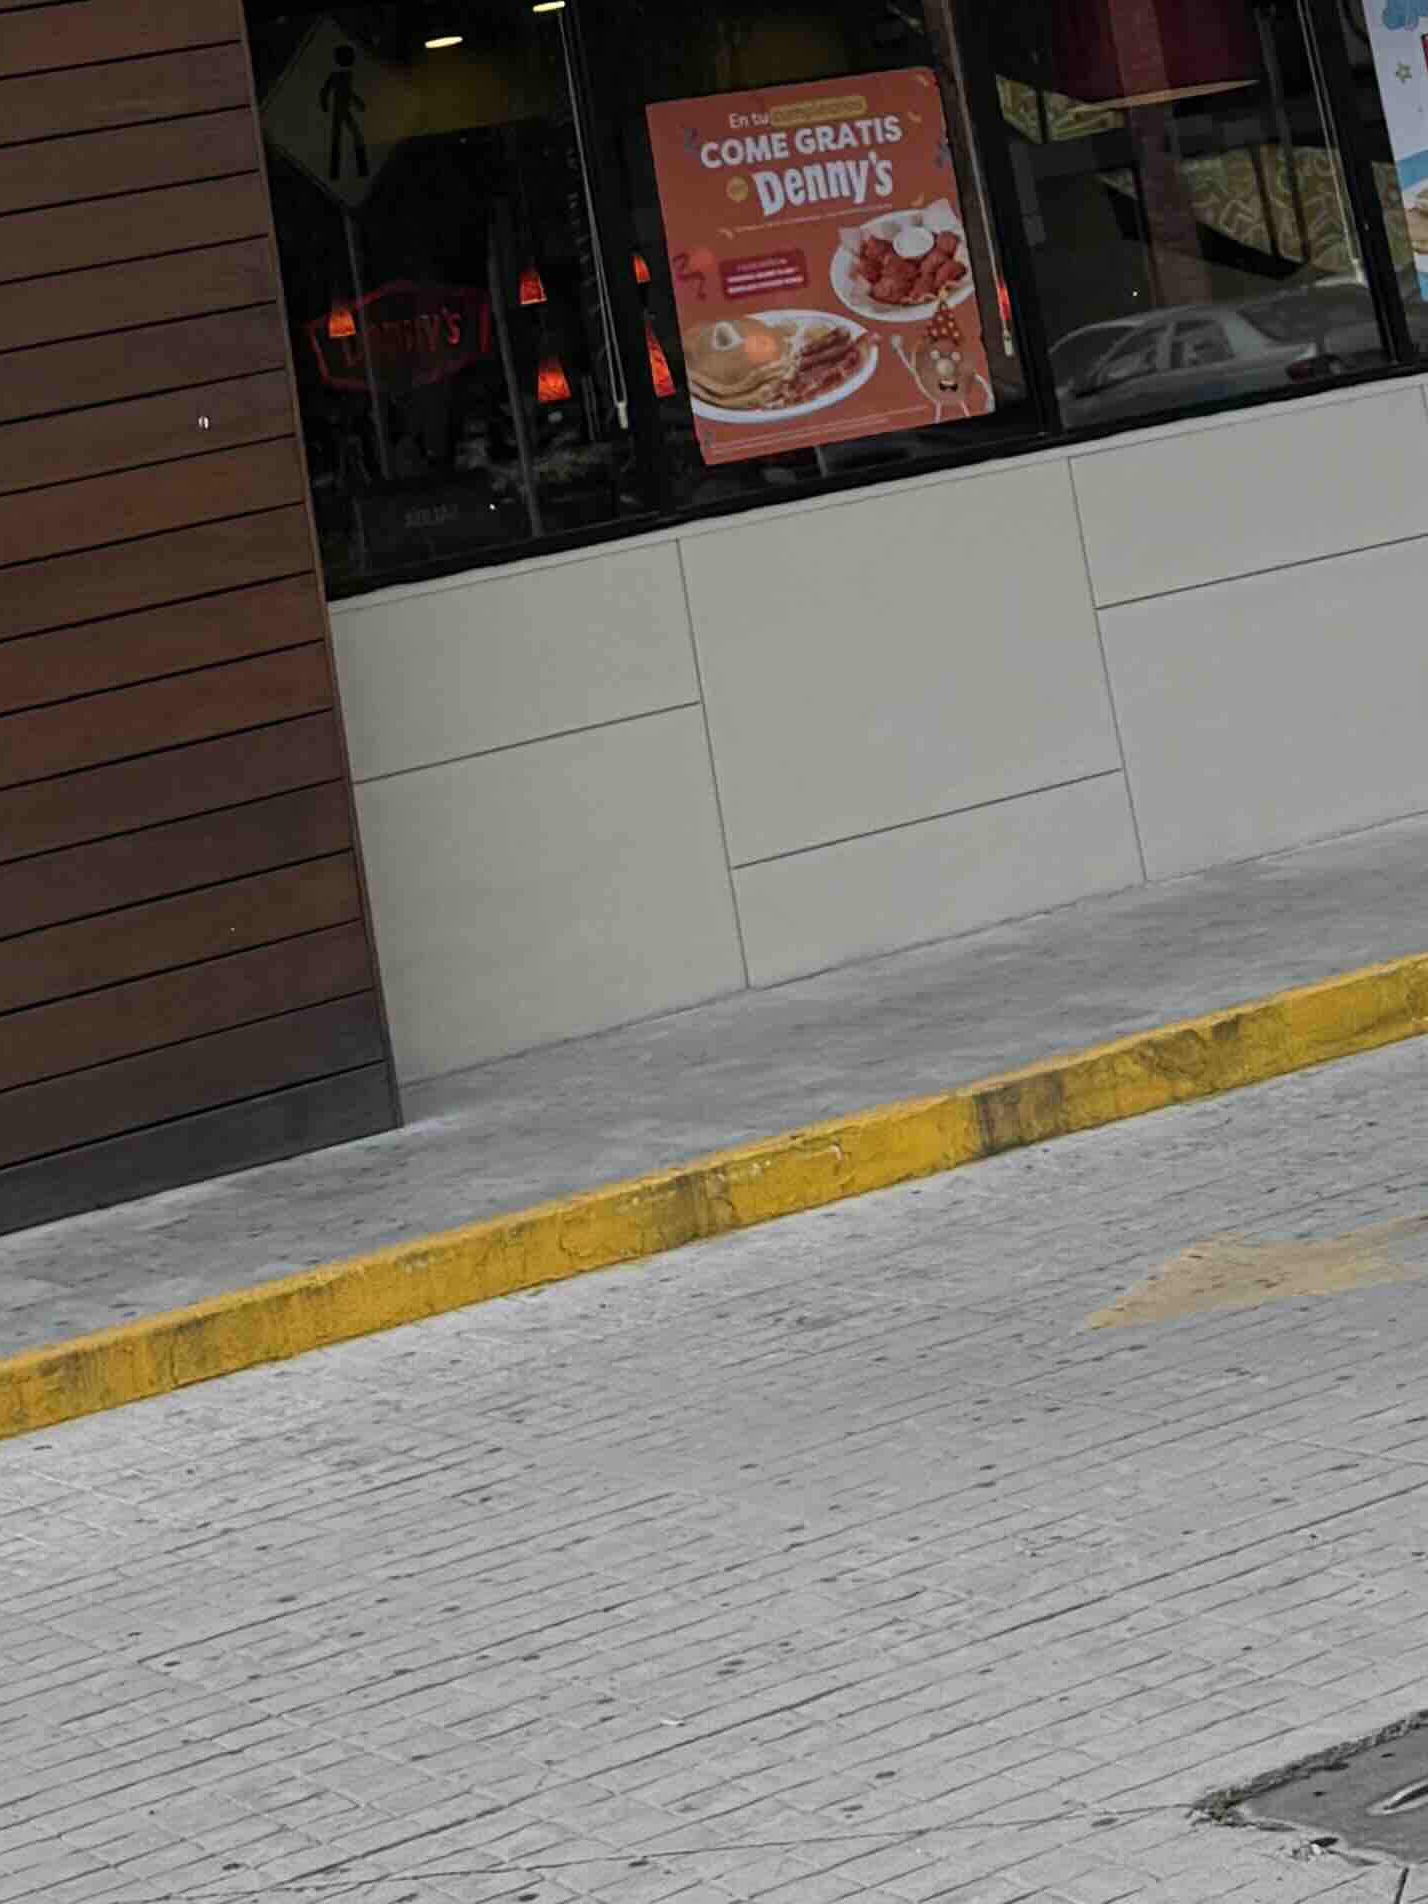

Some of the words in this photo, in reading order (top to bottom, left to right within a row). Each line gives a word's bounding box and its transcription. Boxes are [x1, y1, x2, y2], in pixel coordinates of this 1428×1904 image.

[700, 133, 789, 169] COME
[795, 115, 902, 155] GRATIS
[751, 151, 892, 217] Denny's
